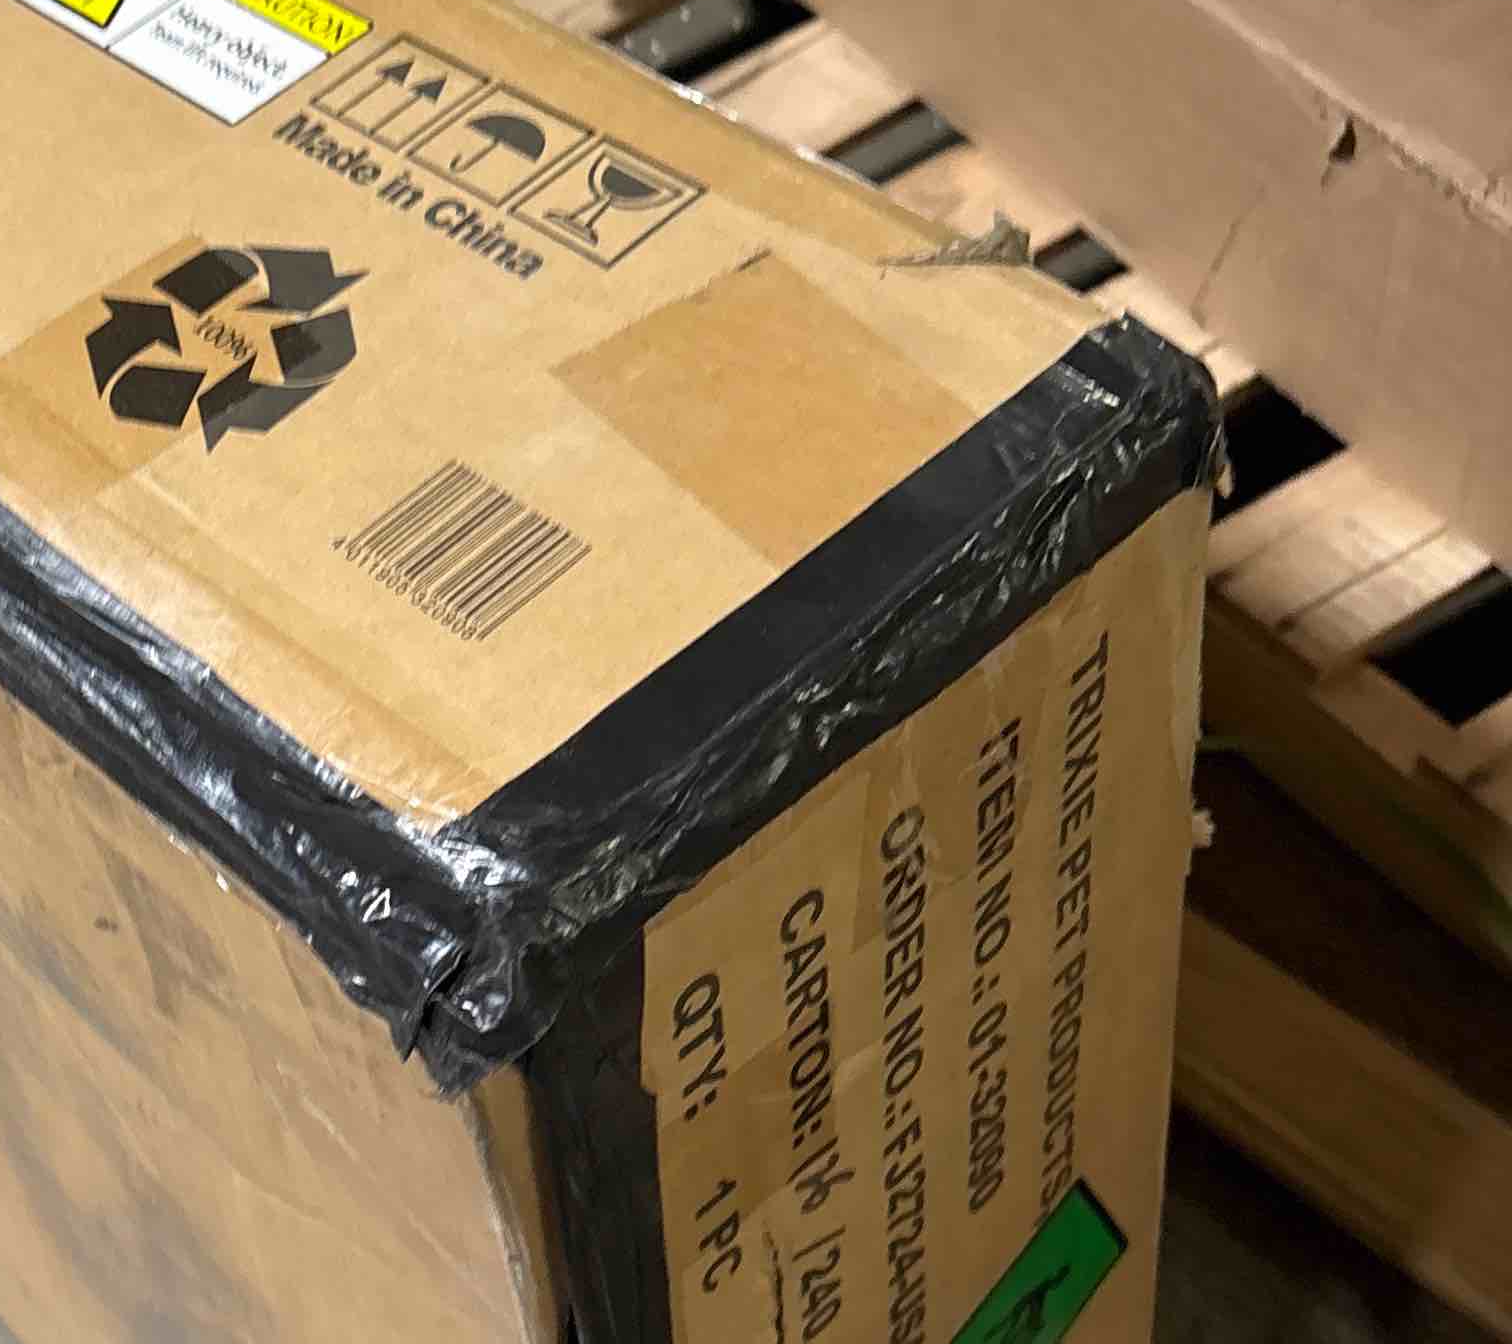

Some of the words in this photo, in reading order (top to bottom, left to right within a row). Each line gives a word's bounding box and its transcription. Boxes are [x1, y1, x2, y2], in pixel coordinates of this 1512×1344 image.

[272, 108, 381, 186] Made
[376, 170, 424, 210] in
[424, 198, 544, 280] China
[977, 716, 1022, 883] ITEM
[1058, 629, 1109, 849] TRIXIE
[880, 805, 926, 1018] ORDER
[1053, 834, 1092, 953] PET
[673, 972, 728, 1121] QTY:
[780, 888, 834, 1150] CARTON:
[967, 1001, 1008, 1215] 01-32090
[694, 1178, 738, 1222] 1
[698, 1210, 743, 1295] PC
